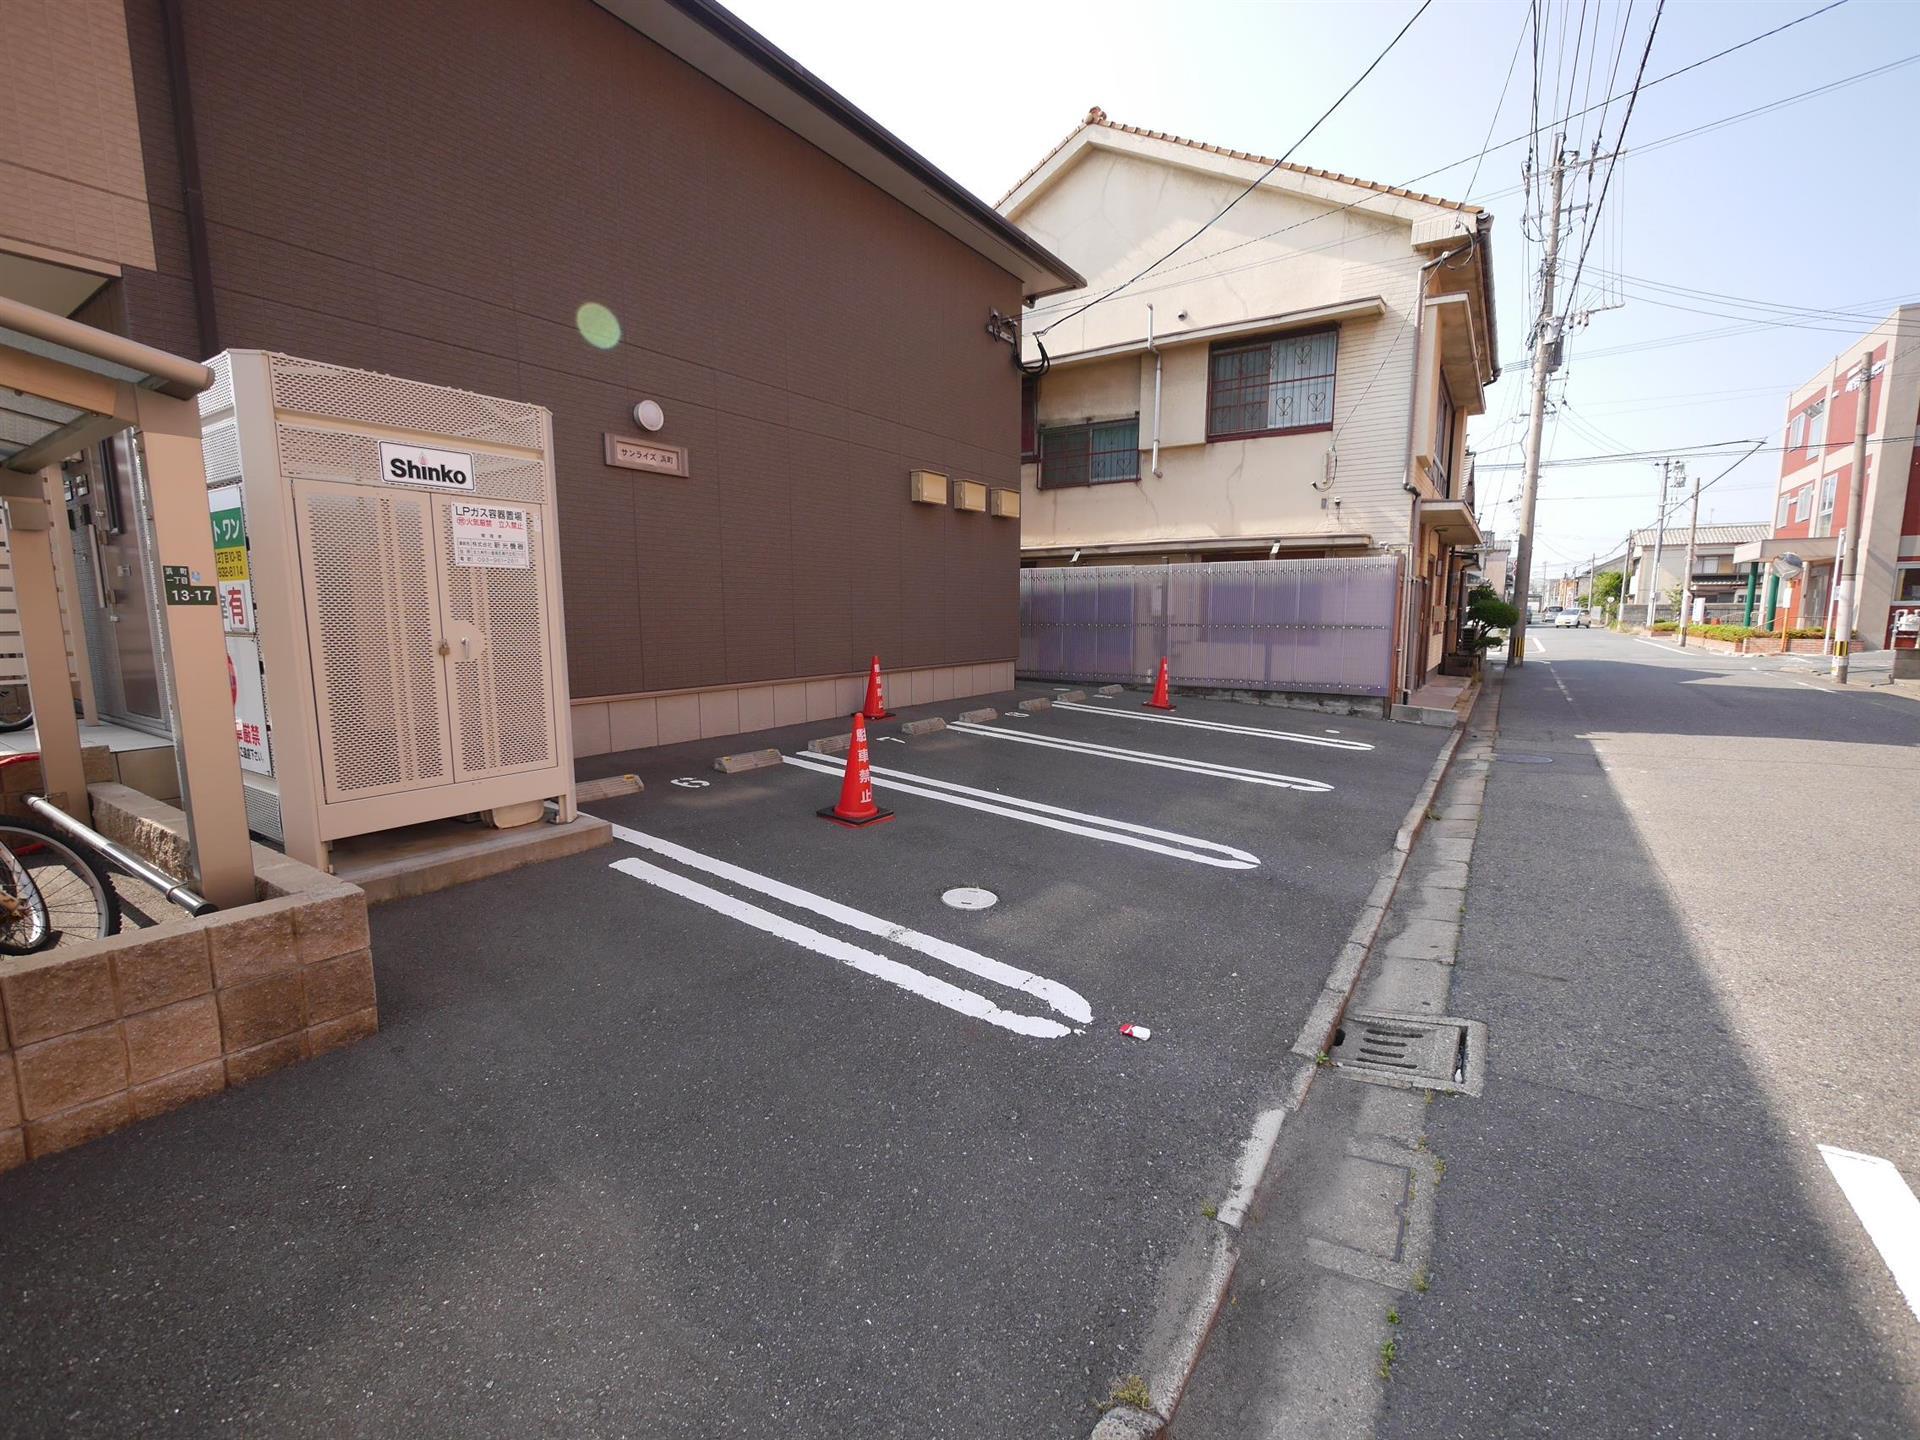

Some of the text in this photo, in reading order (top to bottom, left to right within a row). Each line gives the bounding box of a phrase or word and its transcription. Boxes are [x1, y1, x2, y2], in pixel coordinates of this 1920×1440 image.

[621, 448, 657, 462] サンライズ
[390, 457, 467, 485] Shinko
[166, 576, 188, 585] 一丁目
[171, 589, 212, 601] 13-17
